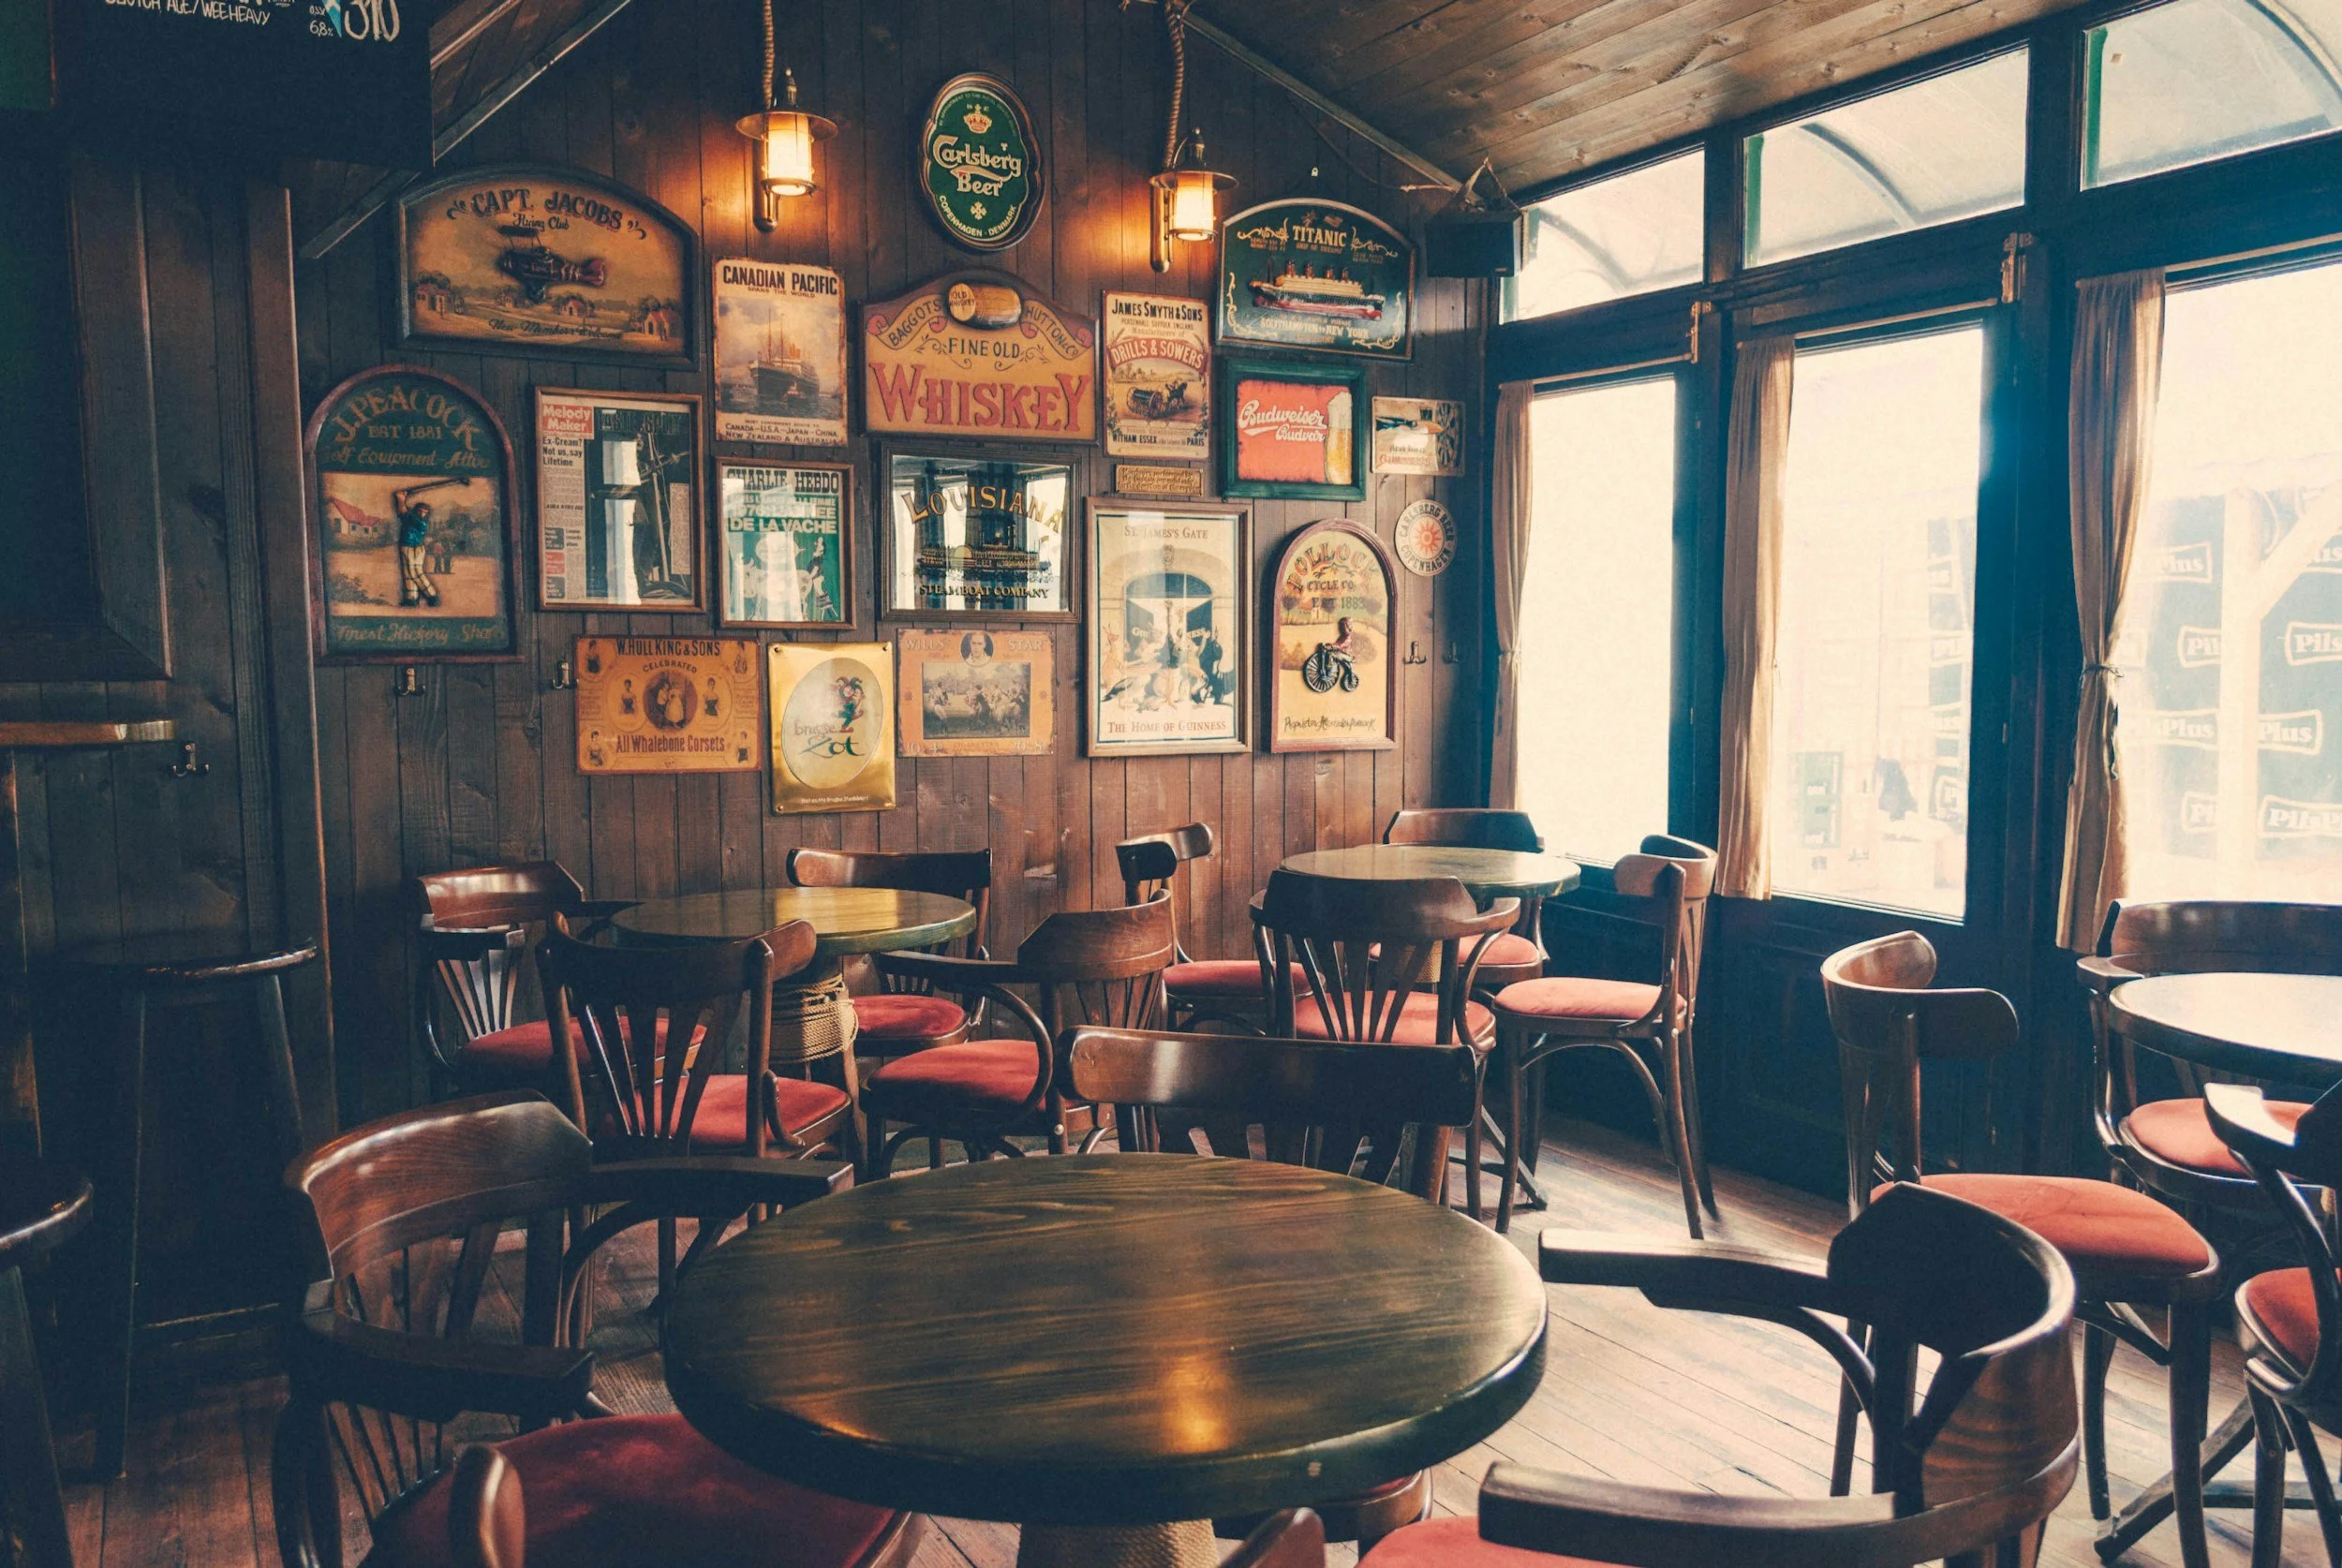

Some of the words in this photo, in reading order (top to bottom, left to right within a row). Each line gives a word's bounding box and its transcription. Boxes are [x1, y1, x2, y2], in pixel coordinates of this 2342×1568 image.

[933, 135, 1022, 180] Carlsberg
[956, 170, 1003, 196] Beer
[470, 188, 535, 218] CAPT.
[544, 190, 624, 232] JACOBS
[939, 195, 983, 237] COPENHAGEN
[987, 205, 1016, 236] DENMARK
[548, 216, 570, 230] Club
[1293, 225, 1347, 247] TITANIC
[722, 265, 785, 289] CANADIAN
[792, 273, 837, 295] PACIFIC
[791, 290, 815, 299] WORLD
[953, 290, 967, 299] OLD
[1112, 299, 1142, 317] JAMES
[1144, 302, 1174, 318] SMYTH
[1176, 307, 1180, 318] &
[1181, 304, 1203, 322] SONS
[888, 299, 941, 348] BAGGOTS
[948, 337, 988, 356] FINE
[993, 341, 1020, 359] OLD
[1110, 339, 1149, 364] DRILLS
[1150, 339, 1158, 356] &
[1160, 339, 1204, 369] SOWERS
[868, 362, 1092, 432] WHISKEY
[543, 405, 591, 422] Melody
[1238, 399, 1327, 429] Budweiser
[547, 418, 586, 432] Maker
[1276, 424, 1326, 442] Budvar
[542, 436, 583, 447] Ex-Cream?
[747, 433, 781, 441] ZEALAND
[1186, 436, 1205, 447] PARIS
[542, 447, 556, 455] Not
[542, 456, 573, 466] Lifetime
[727, 468, 787, 491] CHARLIE
[794, 471, 839, 494] HEBDO
[901, 485, 1065, 534] LOUISIANA
[731, 517, 755, 532] DE
[759, 518, 779, 532] LA
[781, 519, 837, 534] VACHE
[1182, 526, 1208, 540] GATE
[1400, 543, 1452, 573] COPENHAGEN
[919, 585, 990, 597] STEAMBOAT
[993, 586, 1049, 599] COMPANY
[1307, 580, 1340, 591] CYCLE
[655, 640, 682, 657] KING
[683, 645, 690, 656] &
[691, 641, 720, 657] SONS
[643, 659, 698, 673] CELEBRATED
[1107, 721, 1127, 733] THE
[1131, 720, 1161, 732] HOME
[1164, 721, 1176, 732] OF
[616, 735, 630, 753] All
[631, 735, 685, 753] Whalebone
[688, 735, 725, 752] Corsets
[798, 735, 865, 759] Zot
